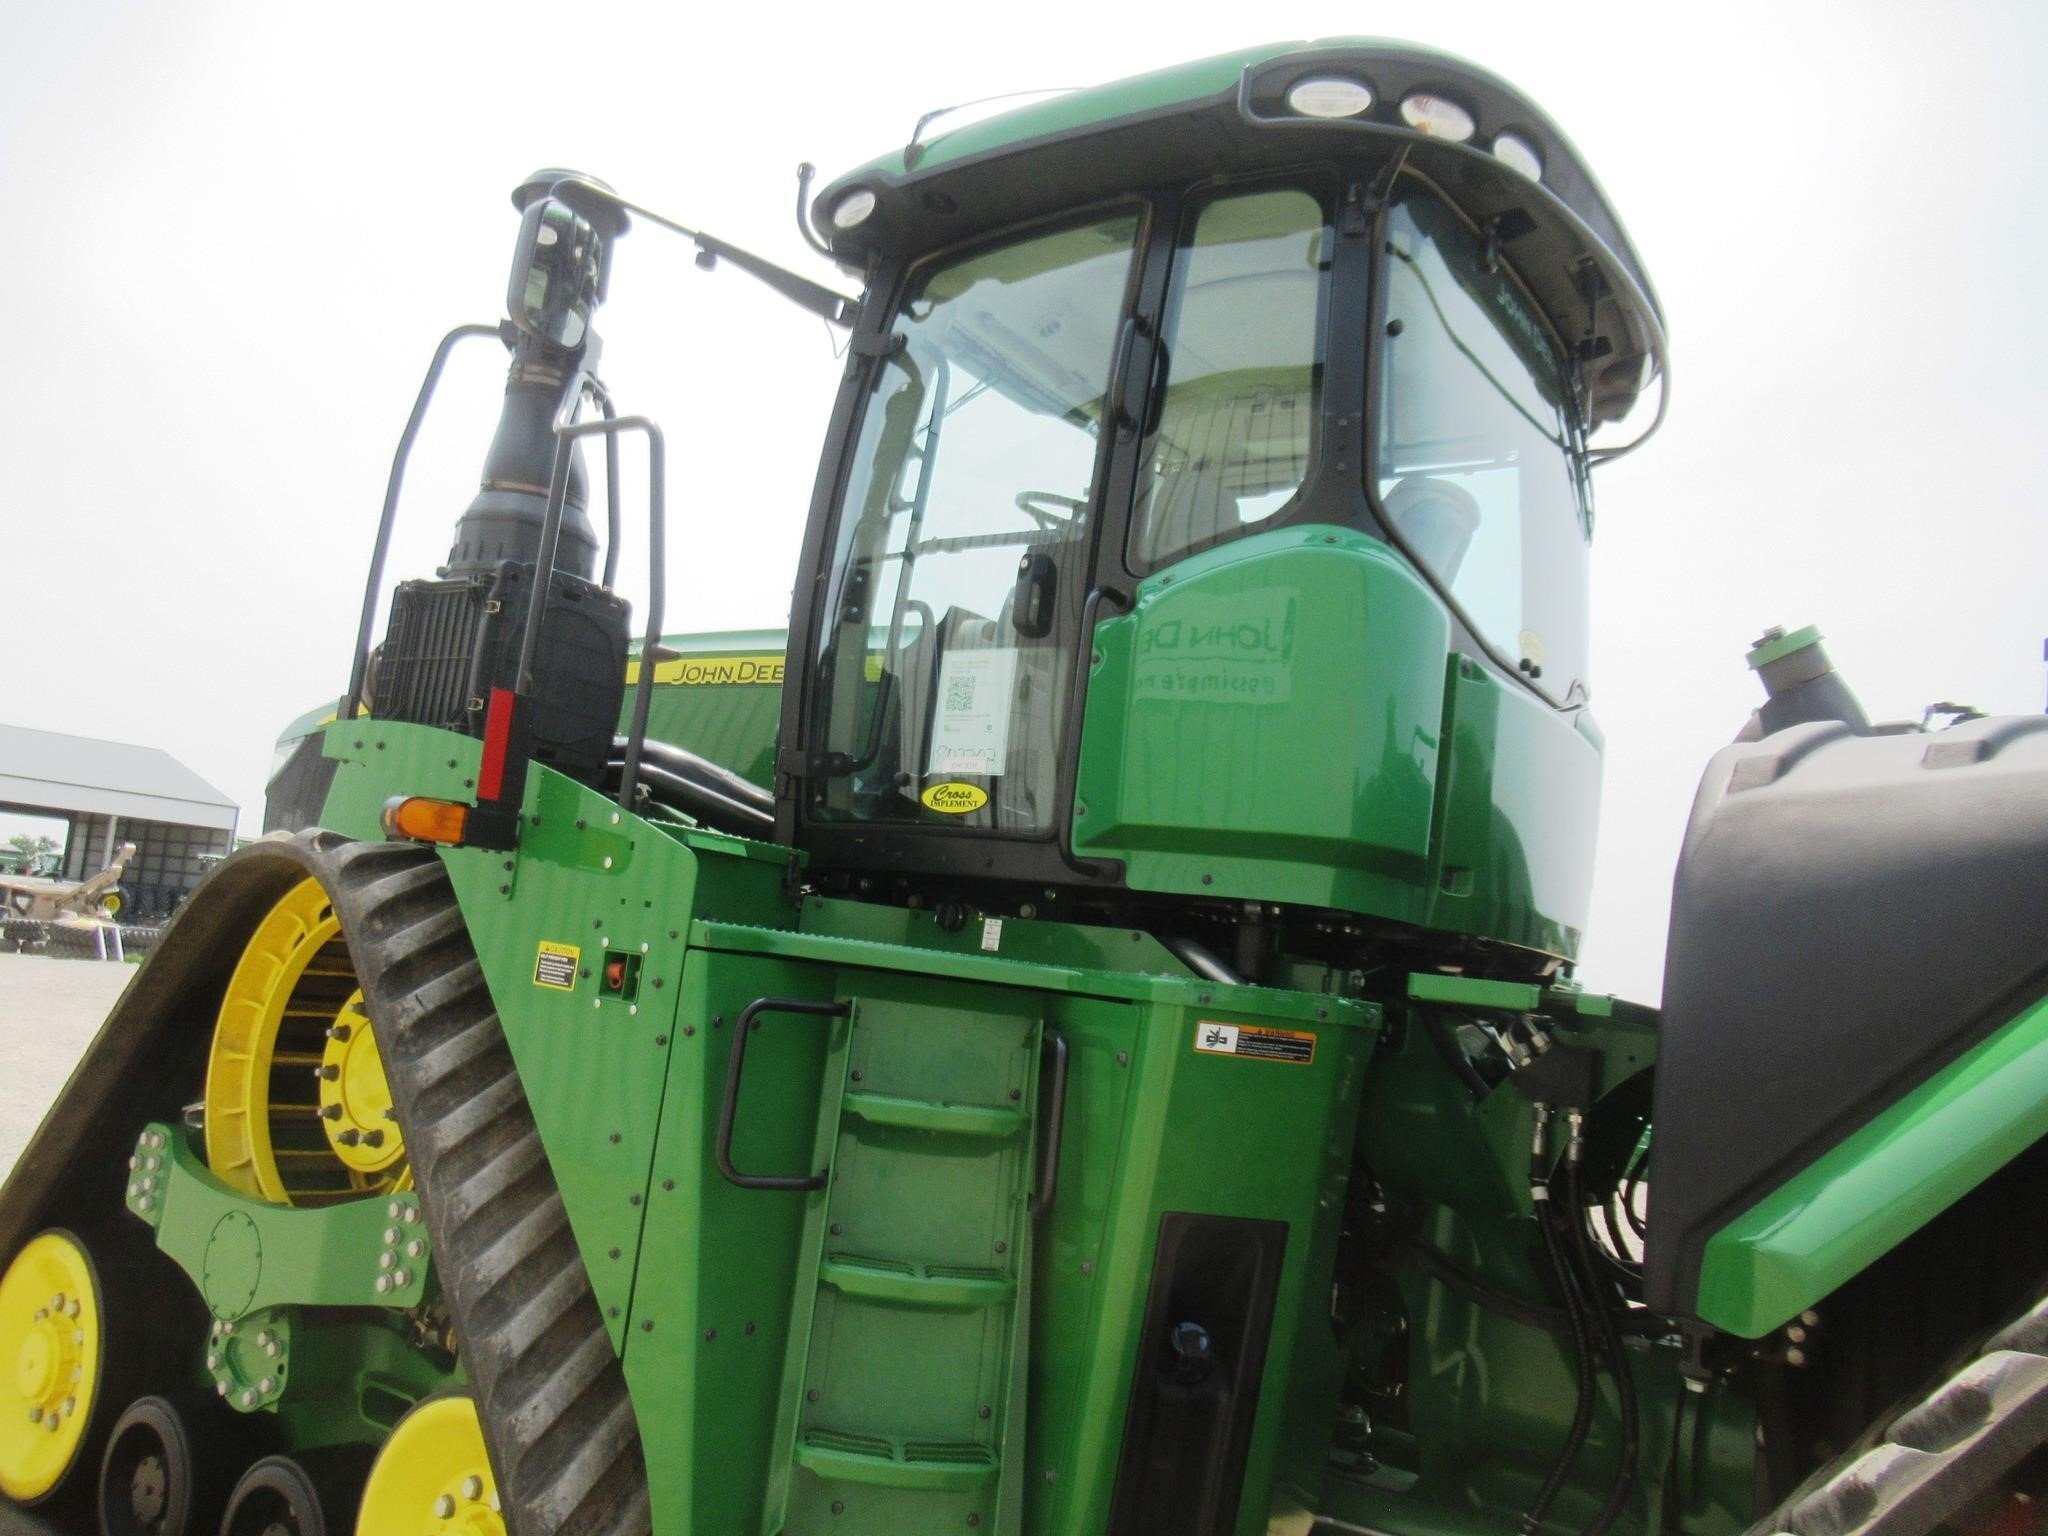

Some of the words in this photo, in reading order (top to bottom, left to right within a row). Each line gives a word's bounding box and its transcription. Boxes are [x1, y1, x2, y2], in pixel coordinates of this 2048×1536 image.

[672, 663, 734, 682] JOHN
[933, 786, 972, 800] Cross
[930, 800, 977, 808] IMPLEMENT
